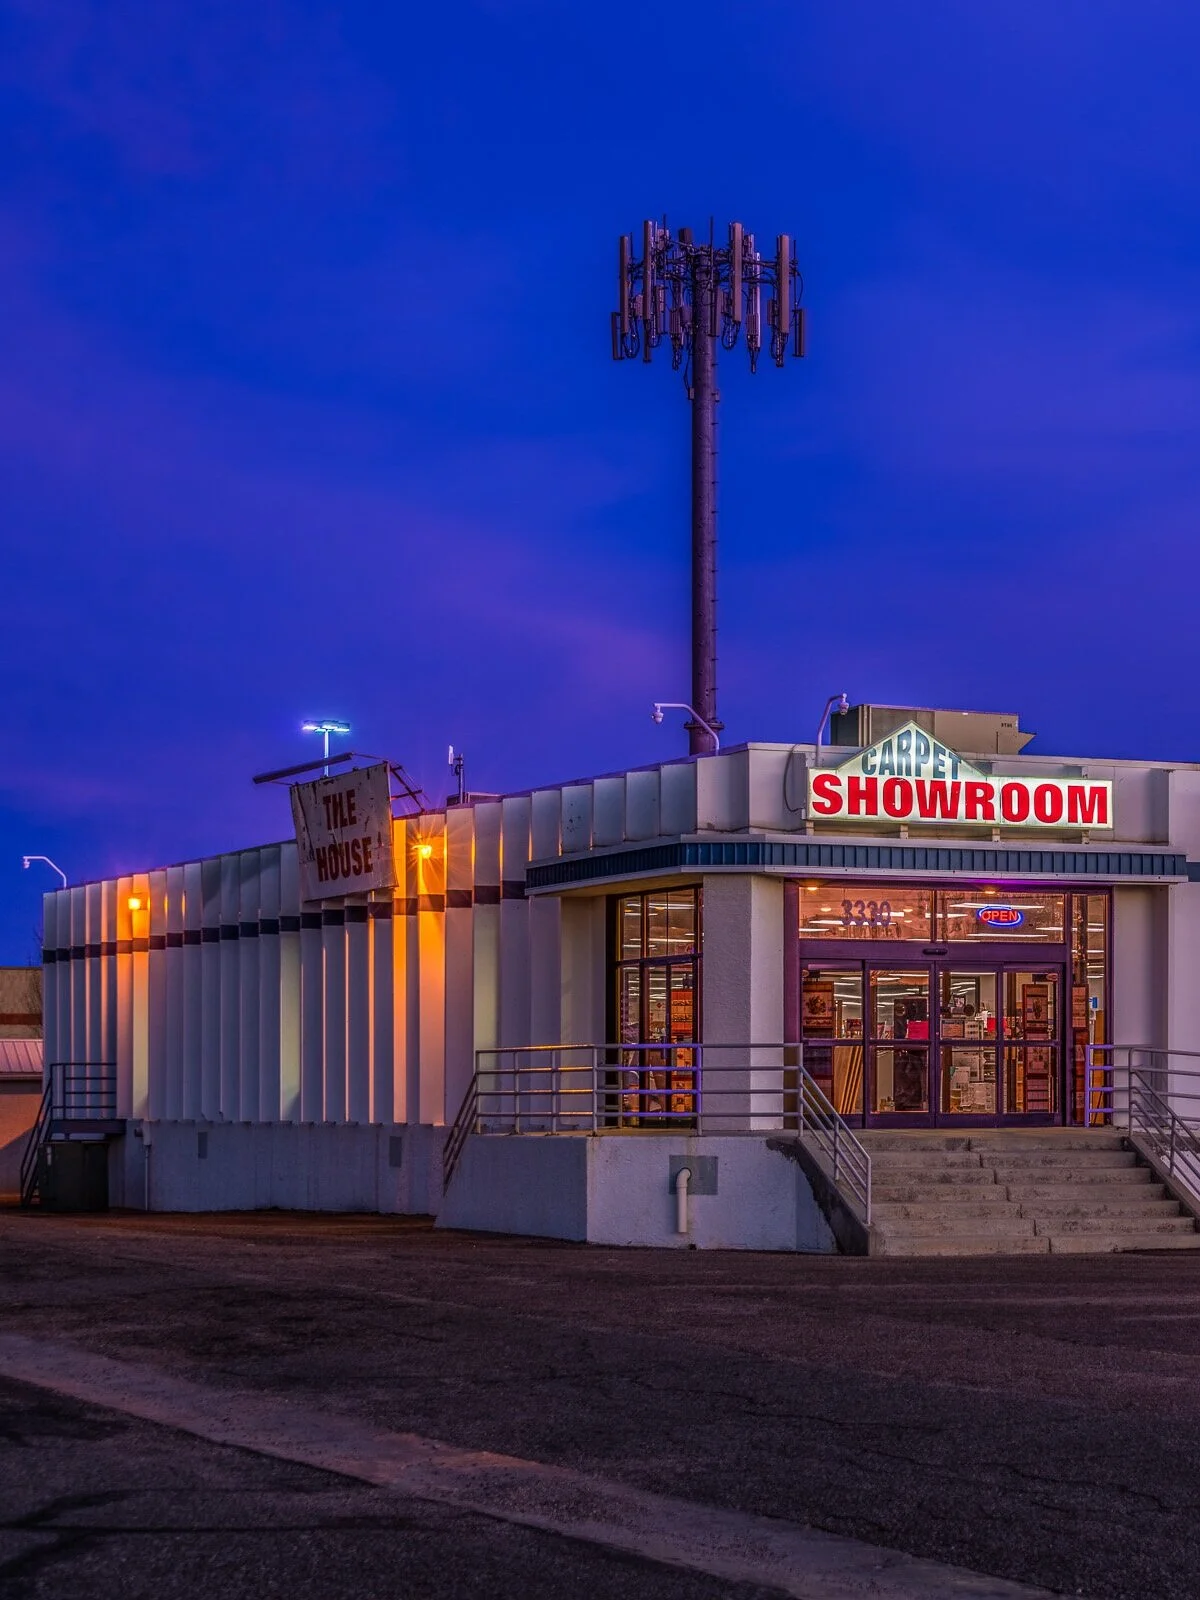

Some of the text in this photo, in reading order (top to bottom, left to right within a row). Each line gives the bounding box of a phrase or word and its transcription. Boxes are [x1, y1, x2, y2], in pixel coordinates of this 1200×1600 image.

[862, 729, 962, 780] CARPET
[323, 789, 357, 830] TILE
[811, 774, 1108, 825] SHOWROOM
[316, 837, 373, 882] HOUSE
[841, 899, 891, 928] 3330
[981, 910, 1018, 921] OPEN
